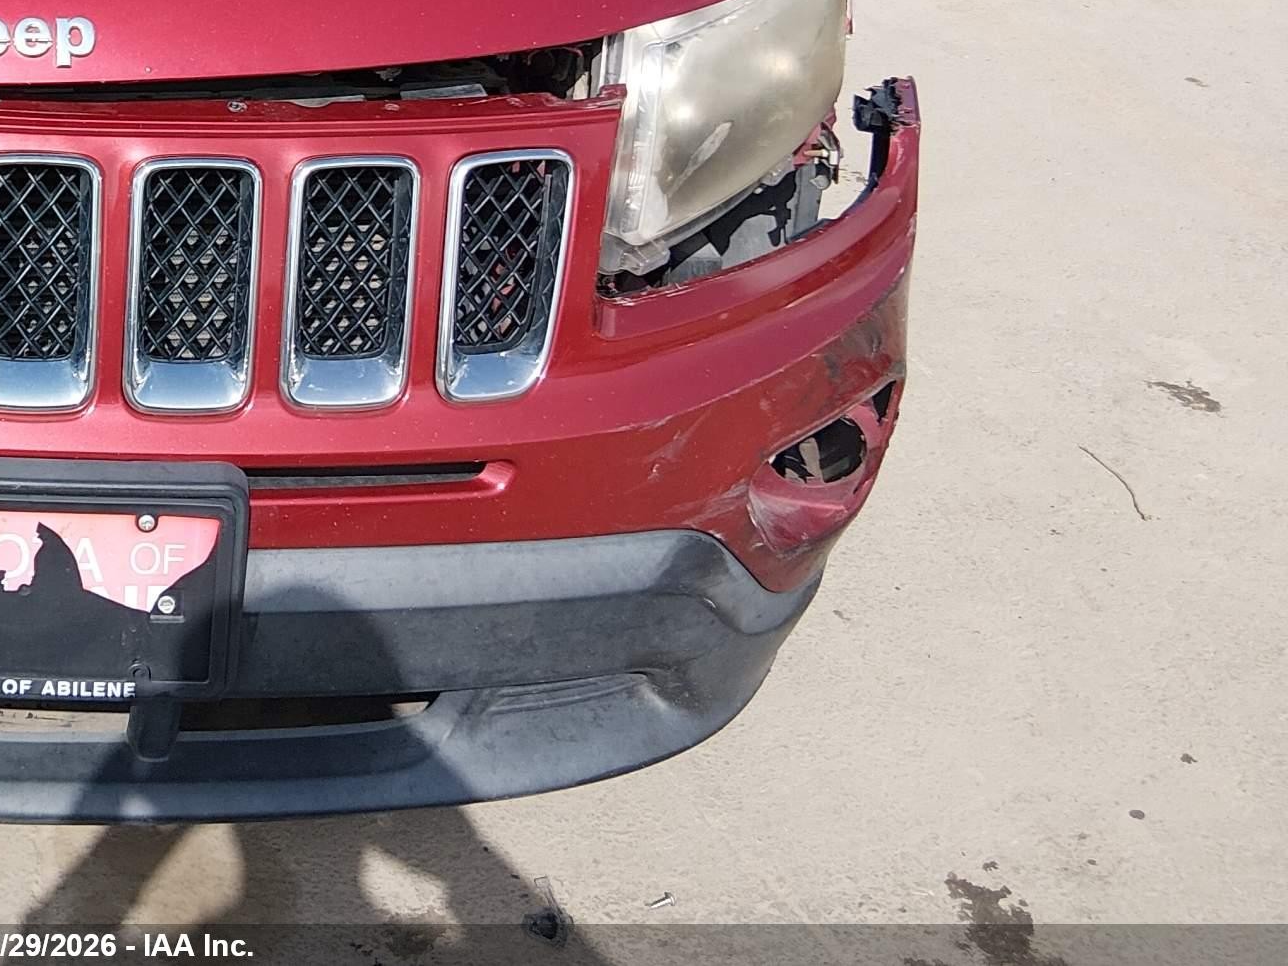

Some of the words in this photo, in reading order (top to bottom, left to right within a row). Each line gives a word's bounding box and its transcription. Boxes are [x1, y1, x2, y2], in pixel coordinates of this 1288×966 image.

[130, 542, 187, 576] OF
[1, 678, 33, 695] OF
[41, 680, 136, 698] ABILENE
